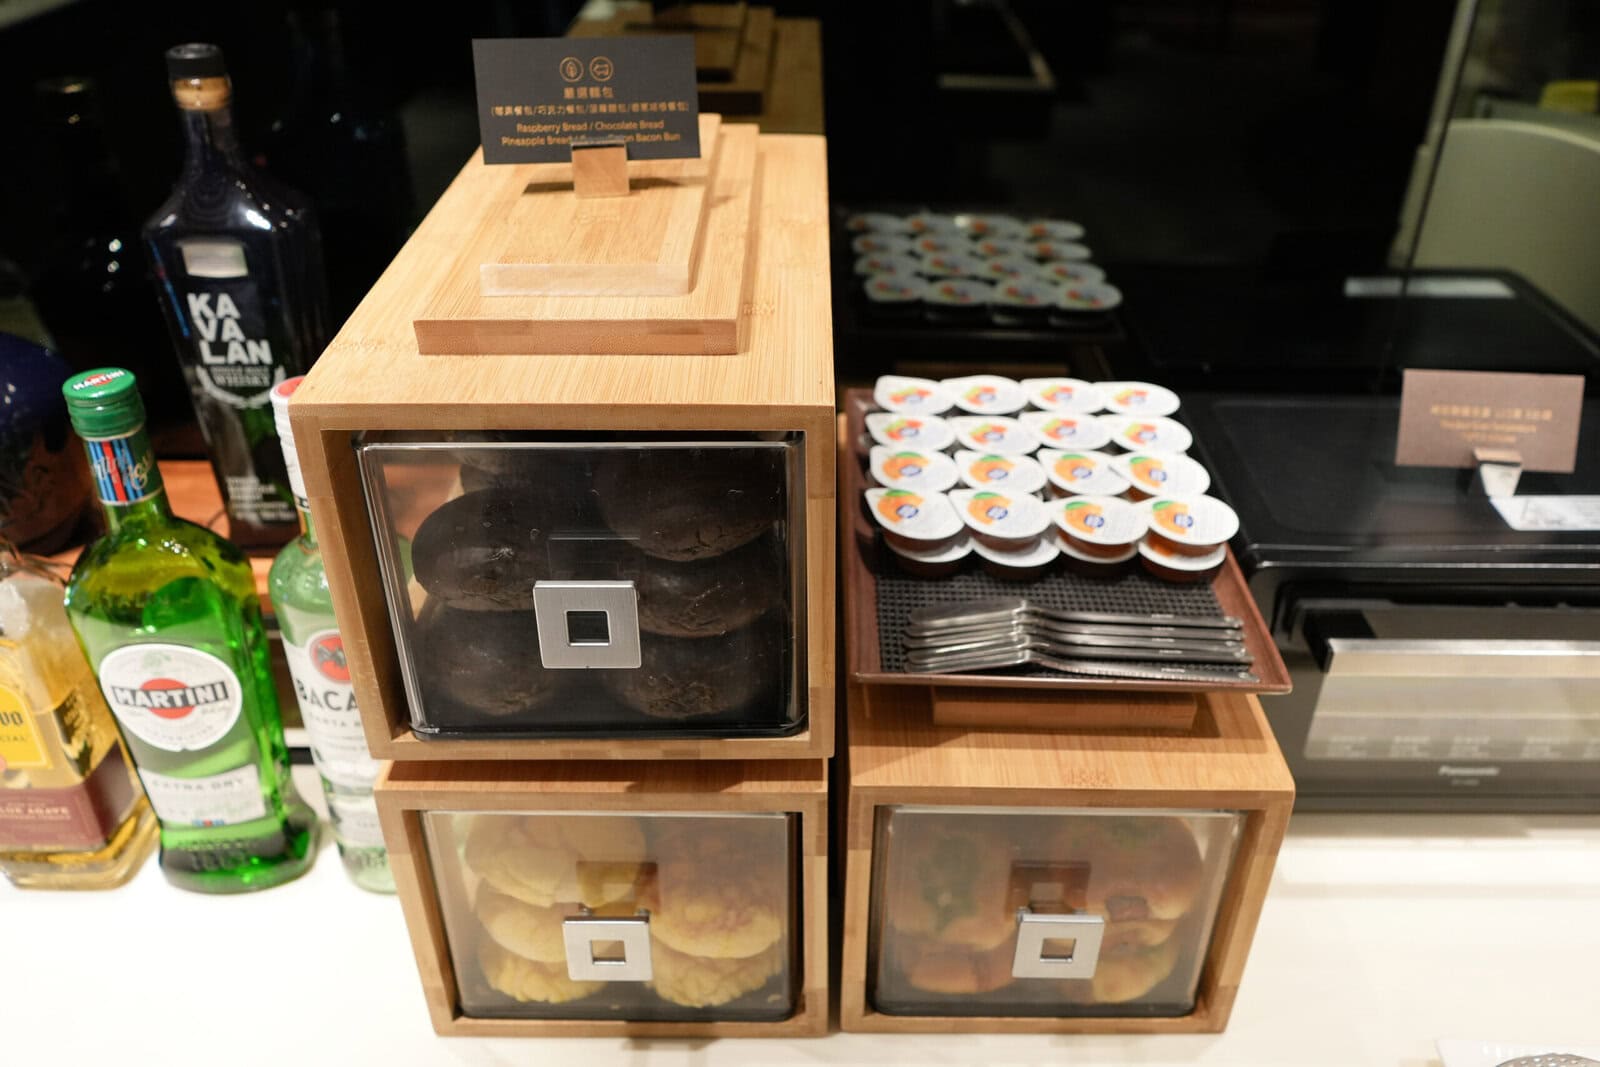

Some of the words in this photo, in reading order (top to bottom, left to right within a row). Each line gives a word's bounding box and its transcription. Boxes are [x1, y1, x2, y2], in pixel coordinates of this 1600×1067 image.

[516, 121, 560, 134] Raspberry
[562, 120, 588, 132] Bread
[595, 119, 637, 131] Chocolate
[639, 119, 664, 129] Bread
[501, 135, 545, 147] Pineapple
[636, 133, 662, 142] Bacon
[663, 131, 681, 141] Bun
[187, 292, 241, 319] KA
[194, 317, 246, 342] VA
[199, 339, 273, 364] LAN
[73, 370, 124, 390] MARTINI
[213, 376, 271, 387] WHISKY
[113, 681, 226, 708] MARTINI
